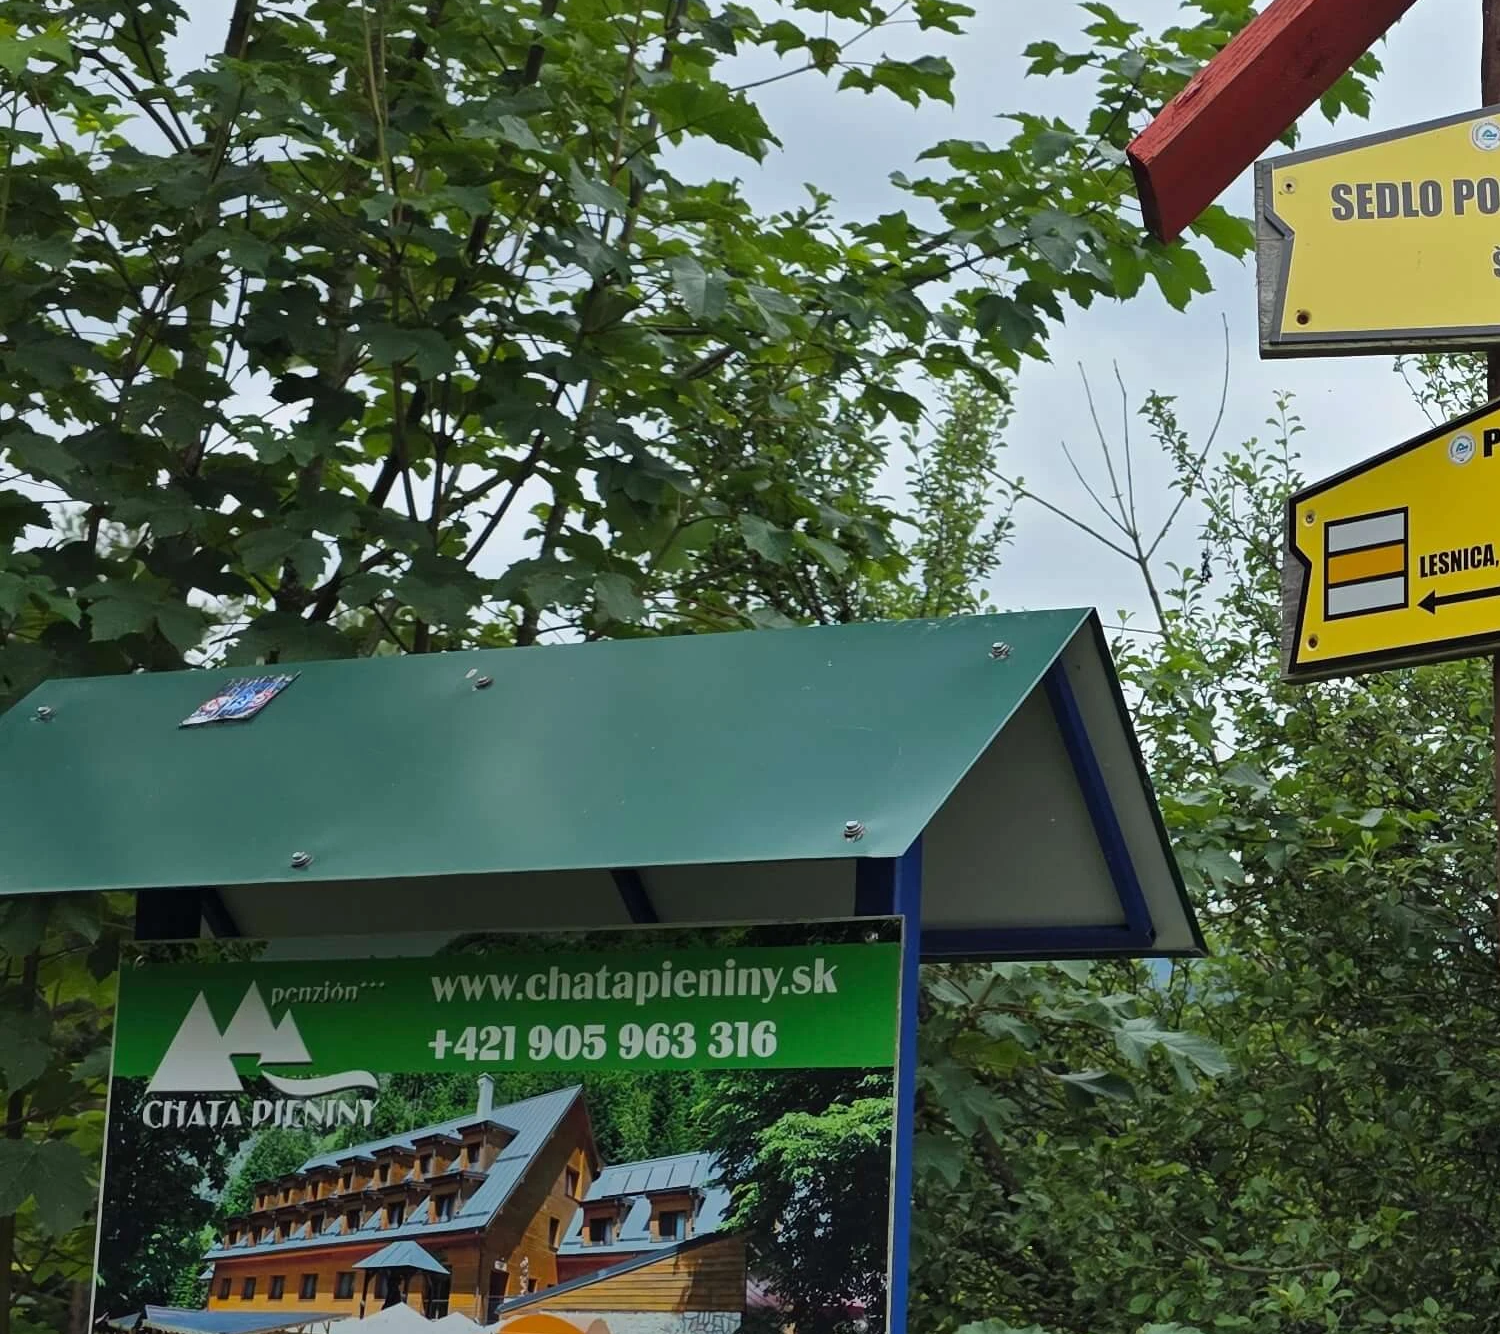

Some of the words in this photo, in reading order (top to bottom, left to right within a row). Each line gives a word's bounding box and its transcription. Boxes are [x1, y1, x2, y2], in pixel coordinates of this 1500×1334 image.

[1331, 180, 1443, 221] SEDLO
[1419, 543, 1500, 578] LESNICA,
[431, 958, 838, 1006] www.chatapieniny.sk
[428, 1025, 516, 1062] +421
[528, 1023, 607, 1061] 905
[618, 1021, 697, 1061] 963
[707, 1020, 777, 1059] 316
[142, 1099, 243, 1129] CHATA
[251, 1098, 380, 1129] PIENINY
